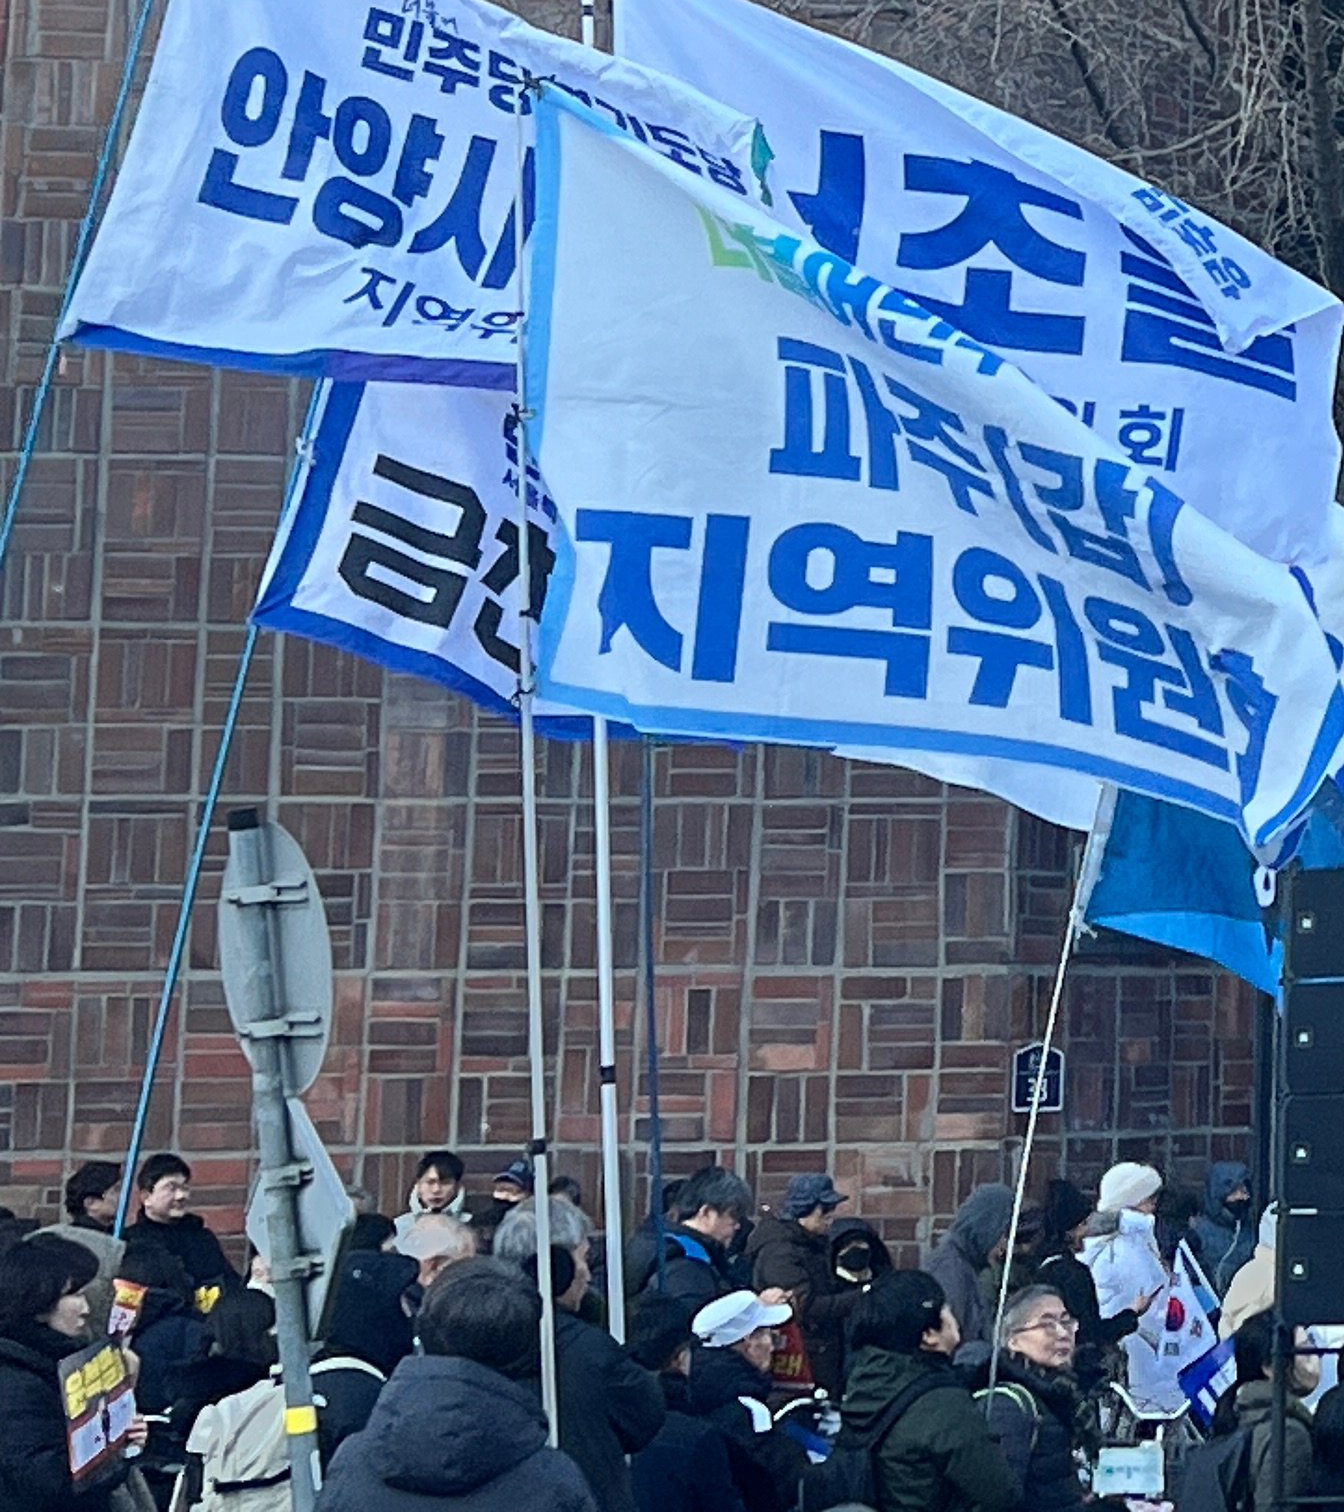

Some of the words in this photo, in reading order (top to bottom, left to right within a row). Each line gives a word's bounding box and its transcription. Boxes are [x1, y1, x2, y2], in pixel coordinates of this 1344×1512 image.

[197, 46, 537, 290] 안양시
[361, 7, 536, 116] 민주당
[553, 78, 748, 196] 기도당
